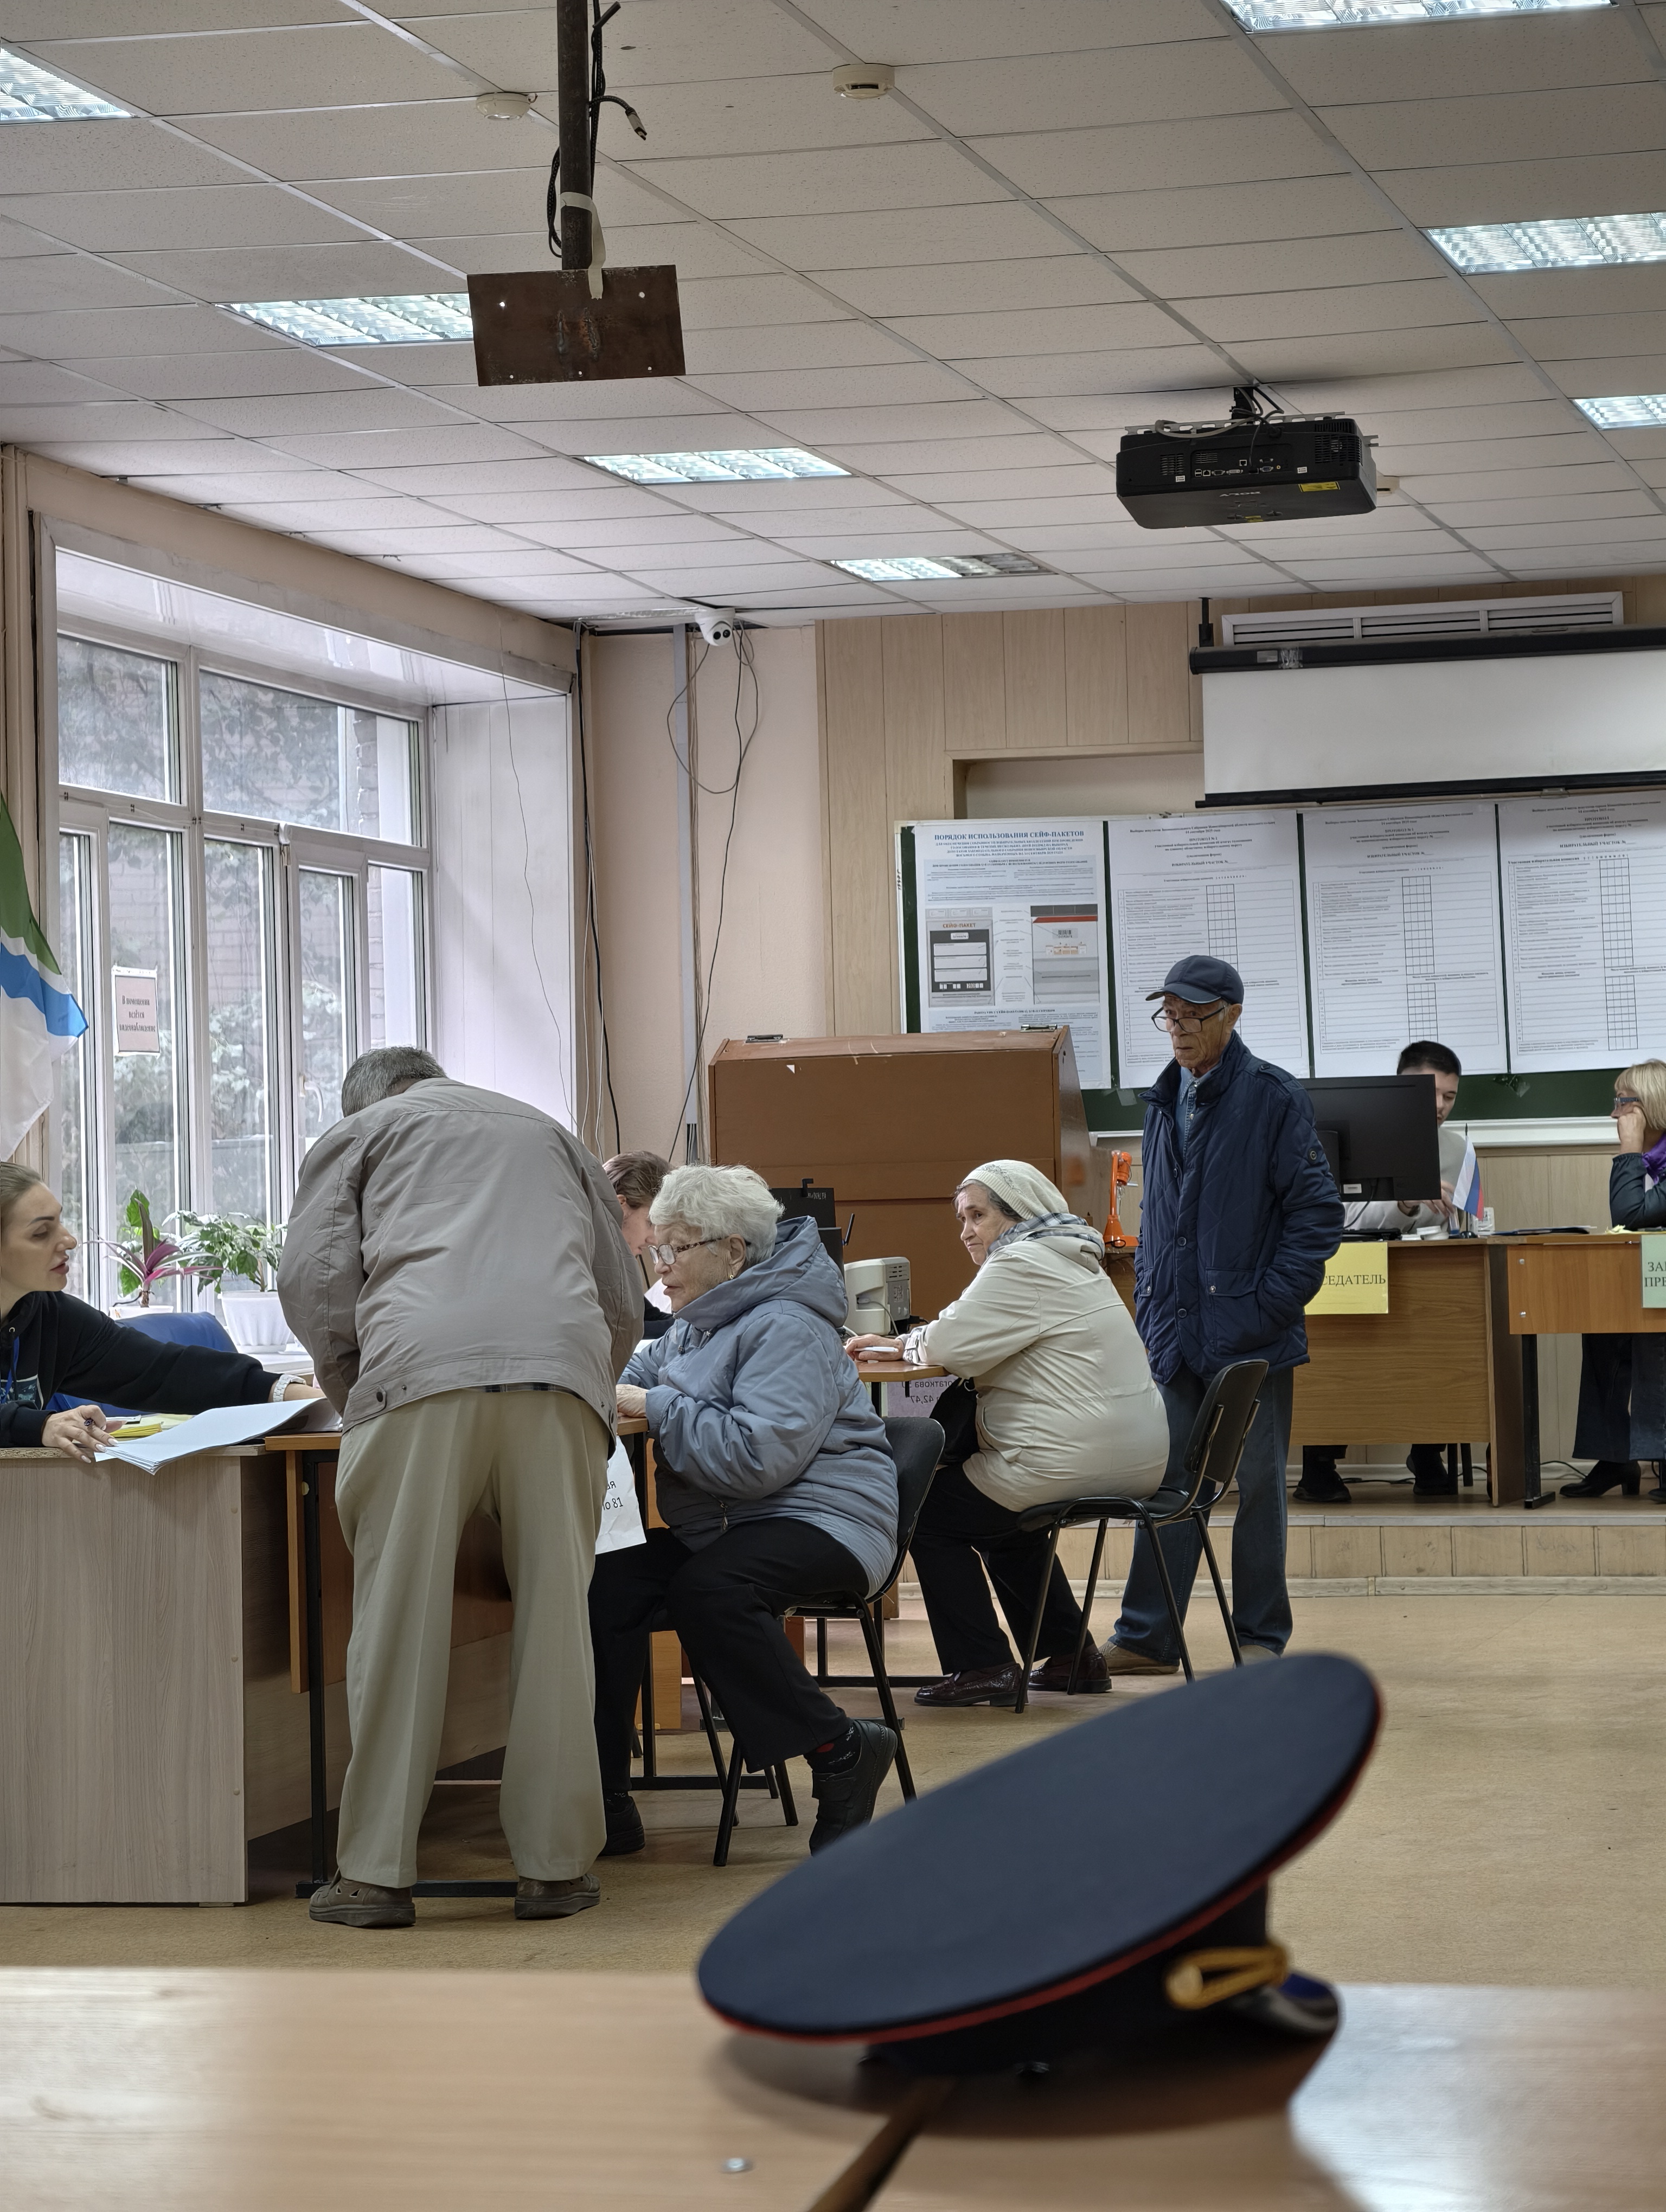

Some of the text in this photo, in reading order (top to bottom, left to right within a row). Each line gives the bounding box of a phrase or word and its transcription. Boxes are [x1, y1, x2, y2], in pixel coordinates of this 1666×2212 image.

[1030, 830, 1084, 838] СЕЙФ-ПАКЕТОВ
[122, 995, 126, 1005] В
[1648, 1262, 1666, 1272] ЗА
[612, 1496, 624, 1509] 81
